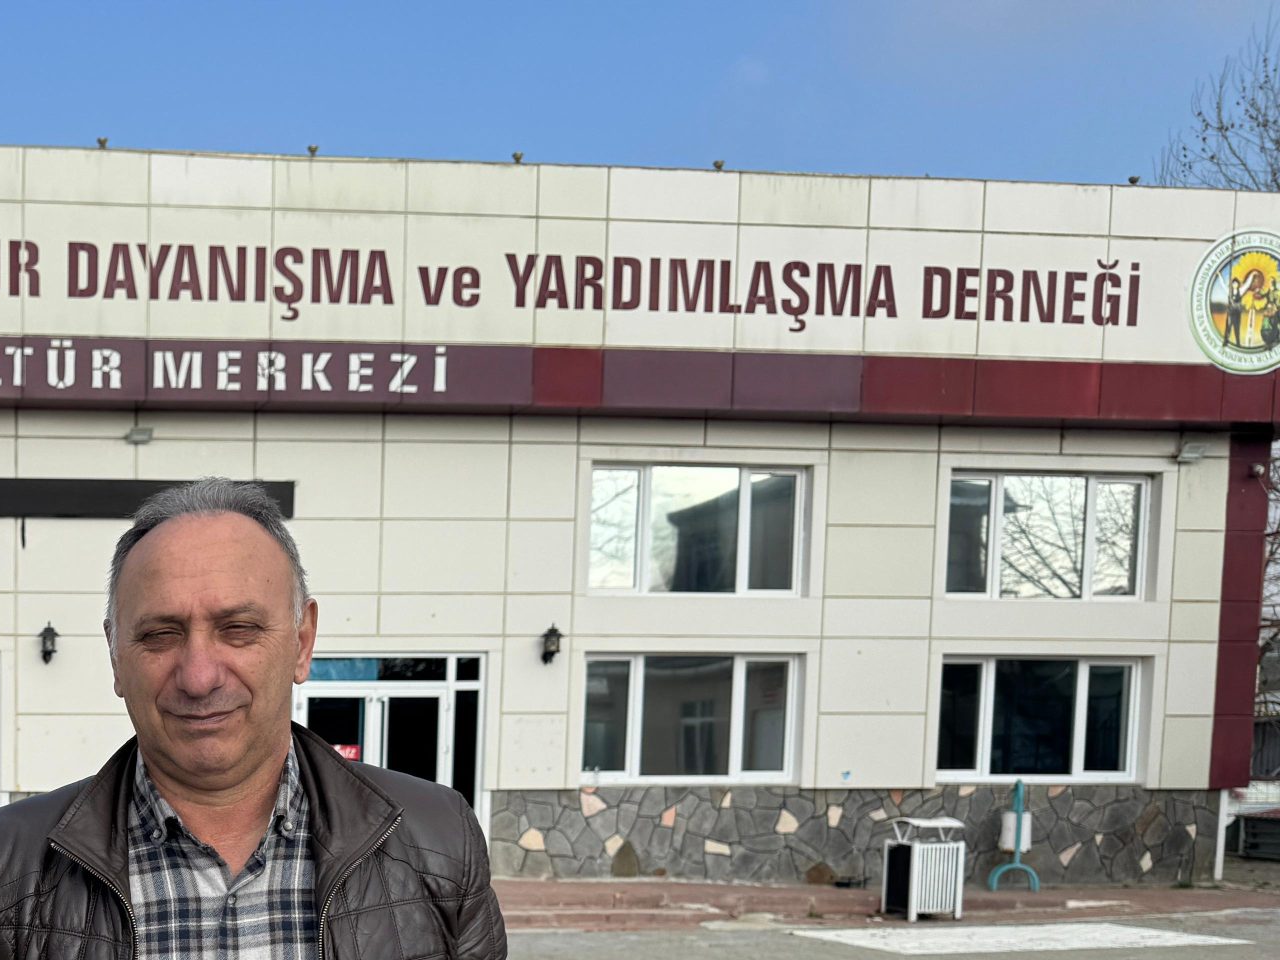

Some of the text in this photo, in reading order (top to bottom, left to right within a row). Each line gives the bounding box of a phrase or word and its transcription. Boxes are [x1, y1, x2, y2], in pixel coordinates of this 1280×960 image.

[66, 241, 395, 322] DAYANIŞMA
[418, 266, 481, 309] ve
[504, 252, 898, 333] YARDIMLAŞMA
[921, 258, 1141, 328] DERNEĞİ
[152, 345, 449, 393] MERKEZİ
